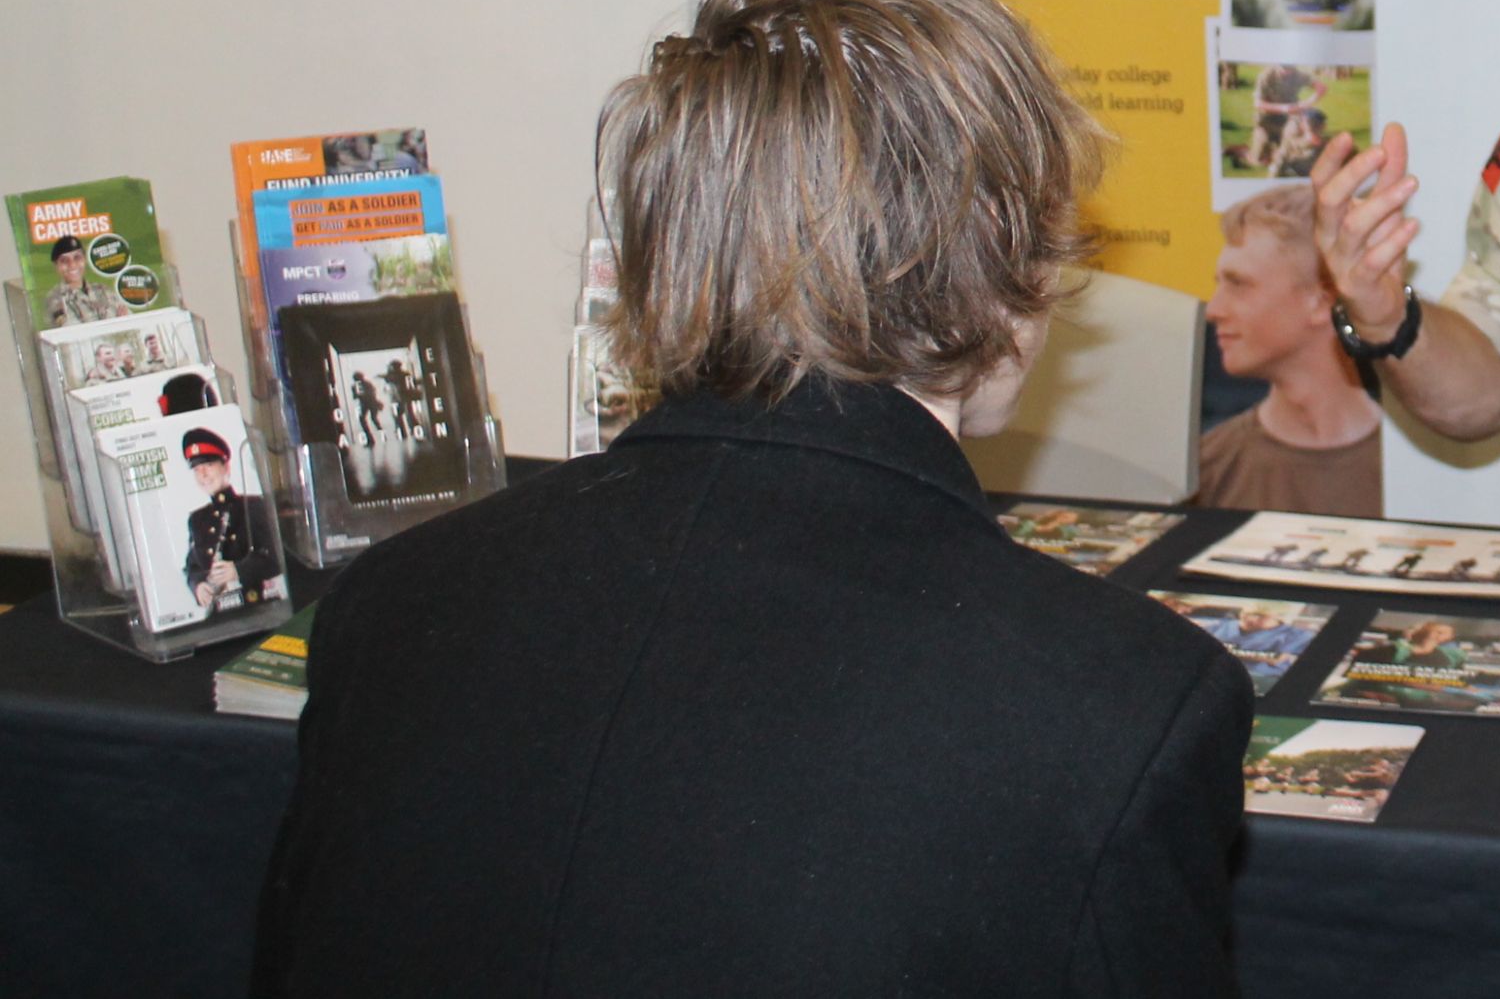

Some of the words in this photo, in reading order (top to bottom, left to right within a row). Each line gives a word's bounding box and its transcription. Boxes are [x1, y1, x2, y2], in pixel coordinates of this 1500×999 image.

[1107, 65, 1172, 85] college
[1109, 92, 1185, 115] learning
[32, 201, 83, 223] ARMY
[294, 201, 324, 216] JOIN
[327, 199, 345, 214] AS
[350, 196, 359, 212] A
[362, 194, 418, 210] SOLDIER
[34, 215, 110, 241] CAREERS
[296, 220, 316, 234] GET
[346, 217, 361, 230] AS
[363, 215, 372, 228] A
[374, 212, 419, 226] SOLDIER
[282, 265, 322, 281] MPCT
[297, 291, 360, 305] PREPARING
[94, 410, 134, 427] CORPS
[119, 448, 167, 469] BRITISH
